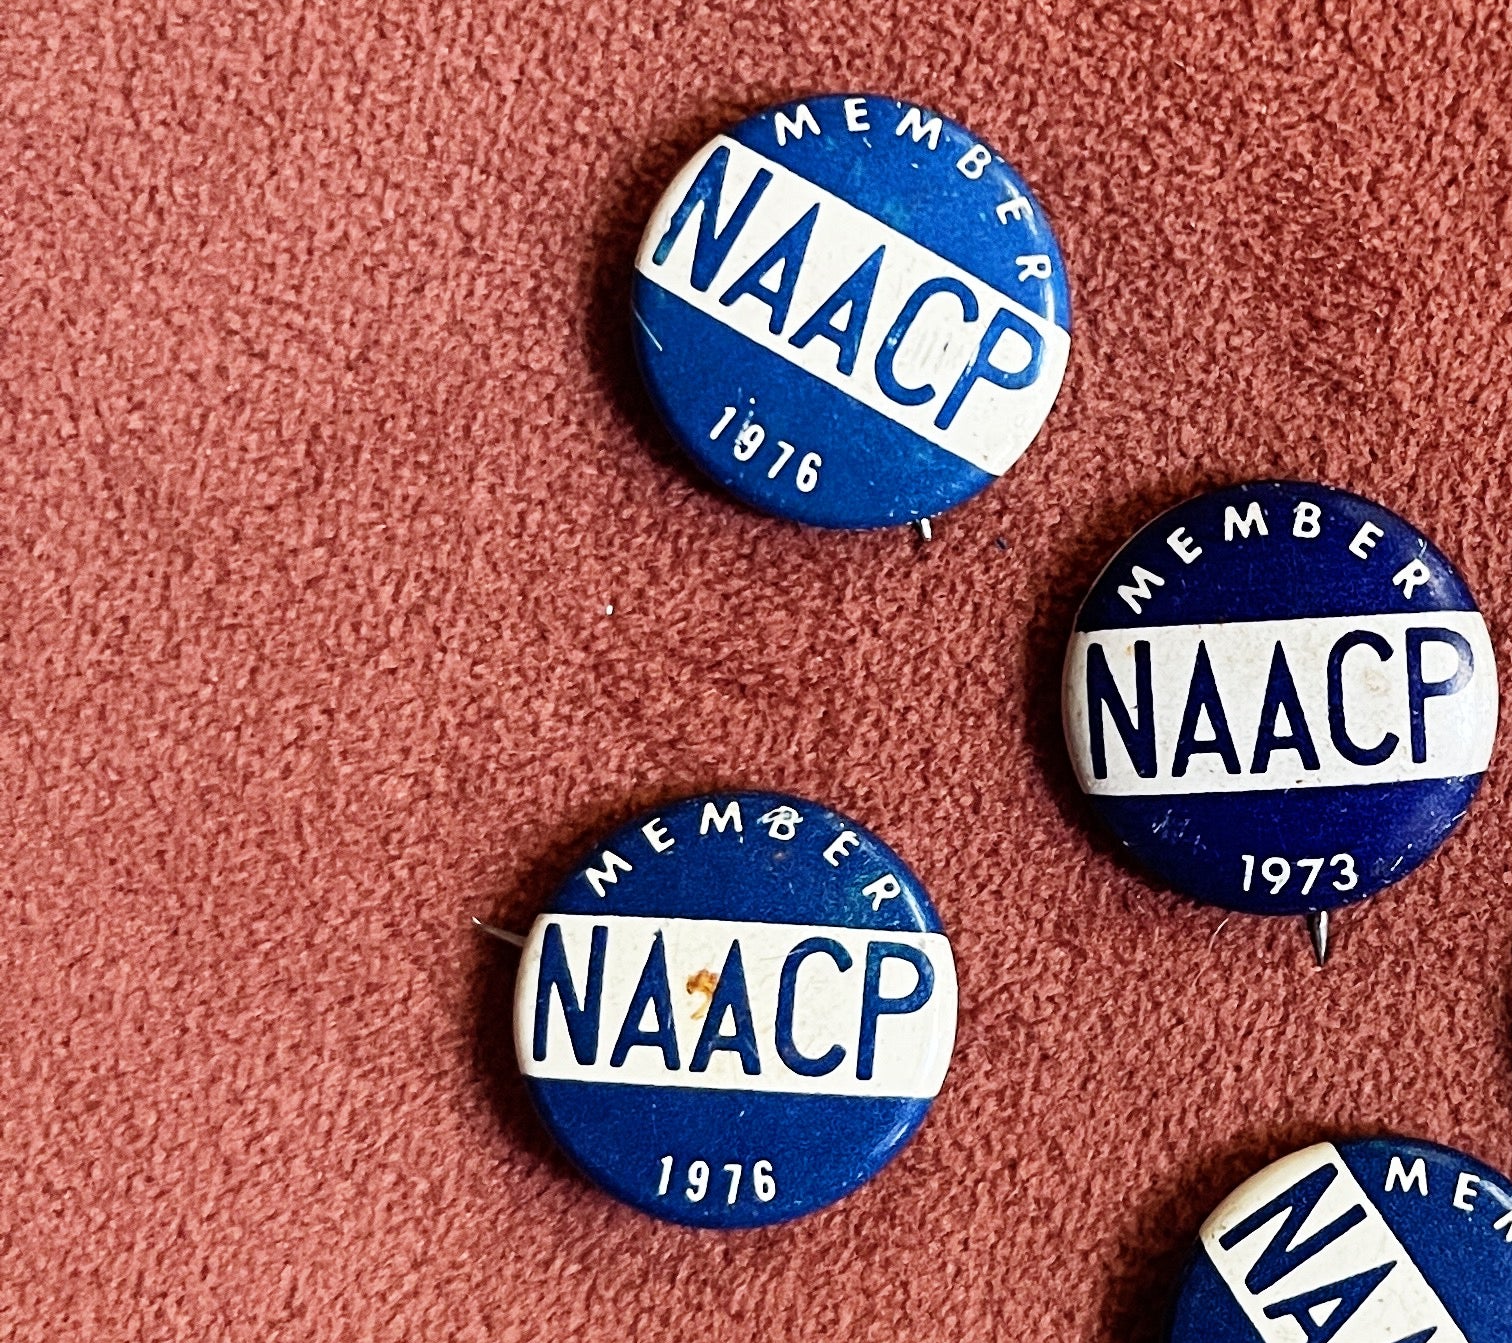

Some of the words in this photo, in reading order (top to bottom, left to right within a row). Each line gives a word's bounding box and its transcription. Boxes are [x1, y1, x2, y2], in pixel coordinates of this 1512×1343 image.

[774, 98, 1052, 282] MEMBER
[652, 146, 1043, 429] NAACP
[709, 406, 822, 492] 1976
[1117, 502, 1430, 614] MEMBER
[1086, 627, 1474, 779] NAACP
[585, 801, 901, 911] MEMBER
[1242, 853, 1357, 894] 1973
[533, 923, 935, 1080] NAACP
[659, 1156, 776, 1204] 1976
